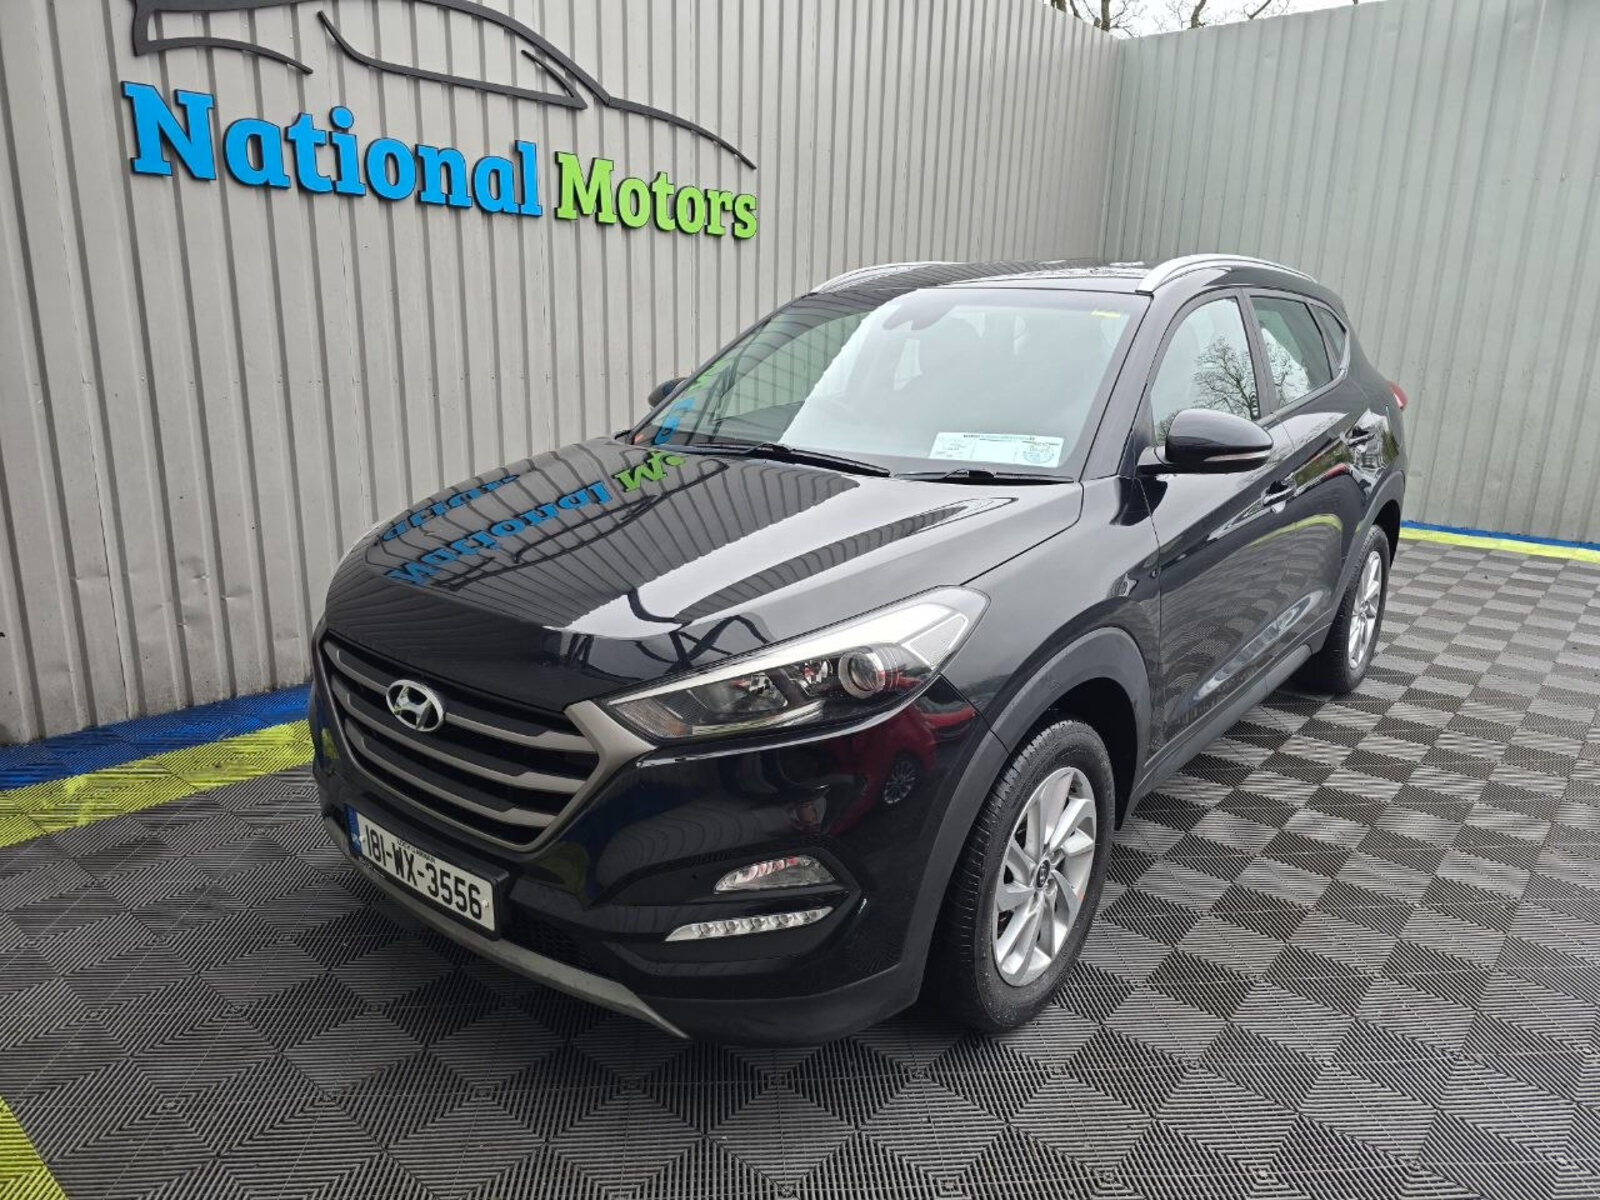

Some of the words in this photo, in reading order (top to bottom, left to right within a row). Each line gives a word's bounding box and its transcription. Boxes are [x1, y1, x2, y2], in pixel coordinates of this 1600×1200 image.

[122, 81, 542, 217] National
[554, 151, 758, 239] Motors
[365, 824, 482, 921] 181-WX-3556
